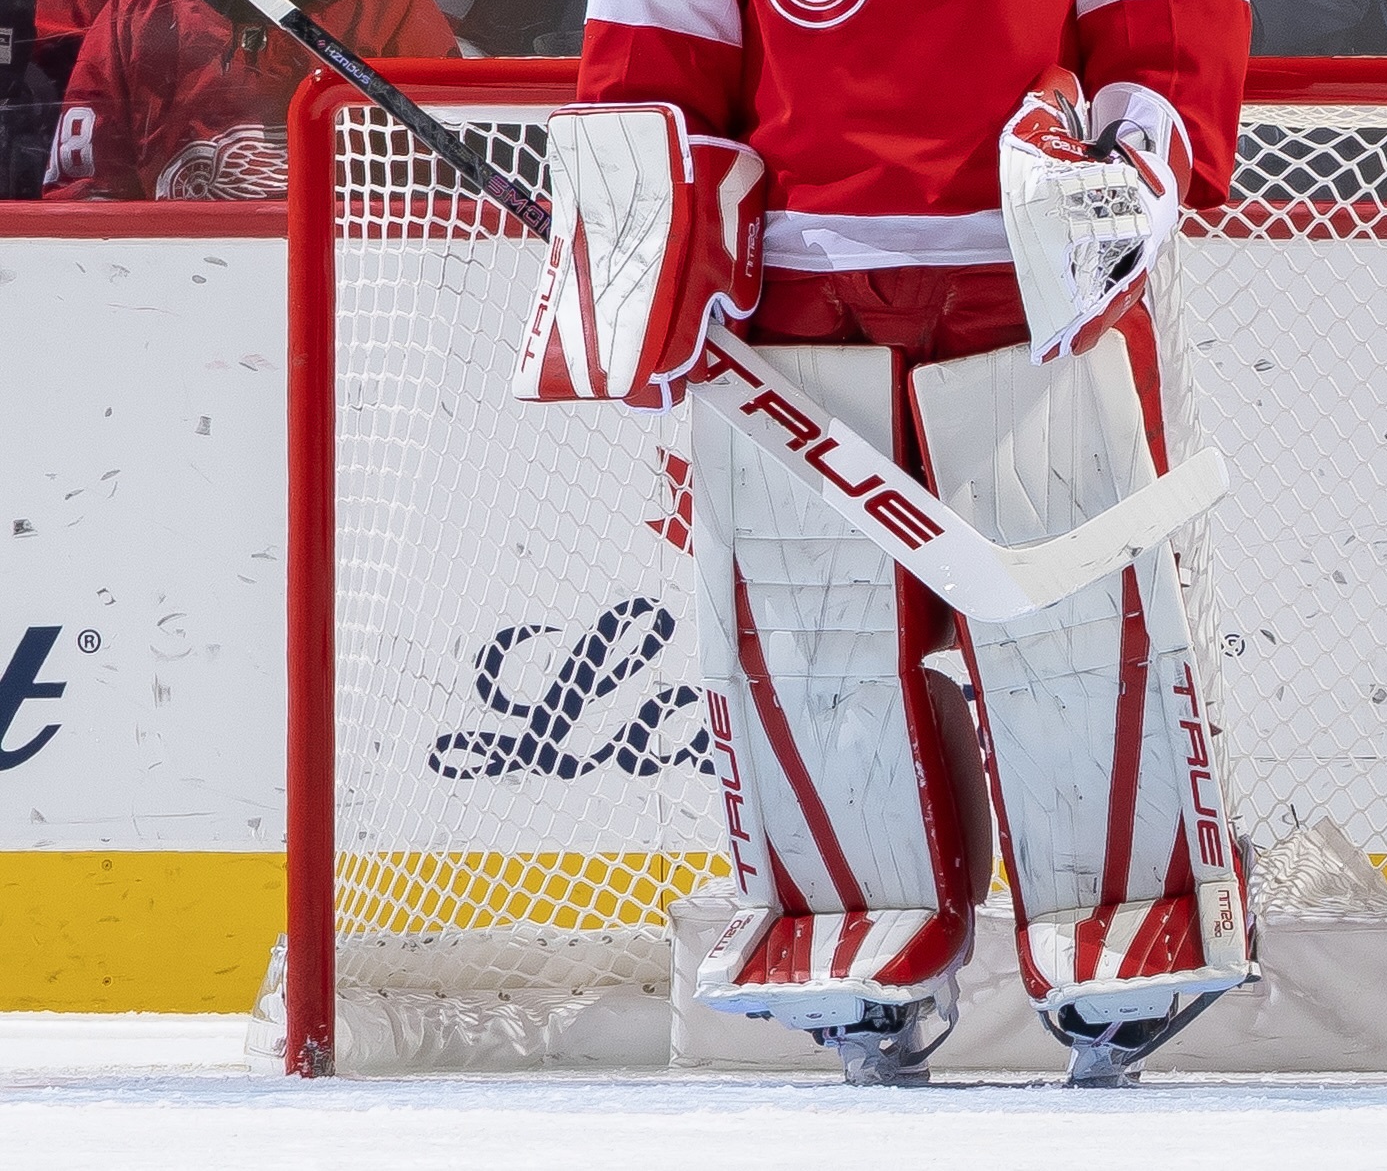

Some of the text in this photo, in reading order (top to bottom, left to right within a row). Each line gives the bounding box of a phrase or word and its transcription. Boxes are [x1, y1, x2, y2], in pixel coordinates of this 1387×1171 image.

[522, 233, 563, 373] TRUE
[696, 338, 946, 552] TRUE
[706, 688, 758, 896] TRUE
[1173, 660, 1226, 868] TRUE
